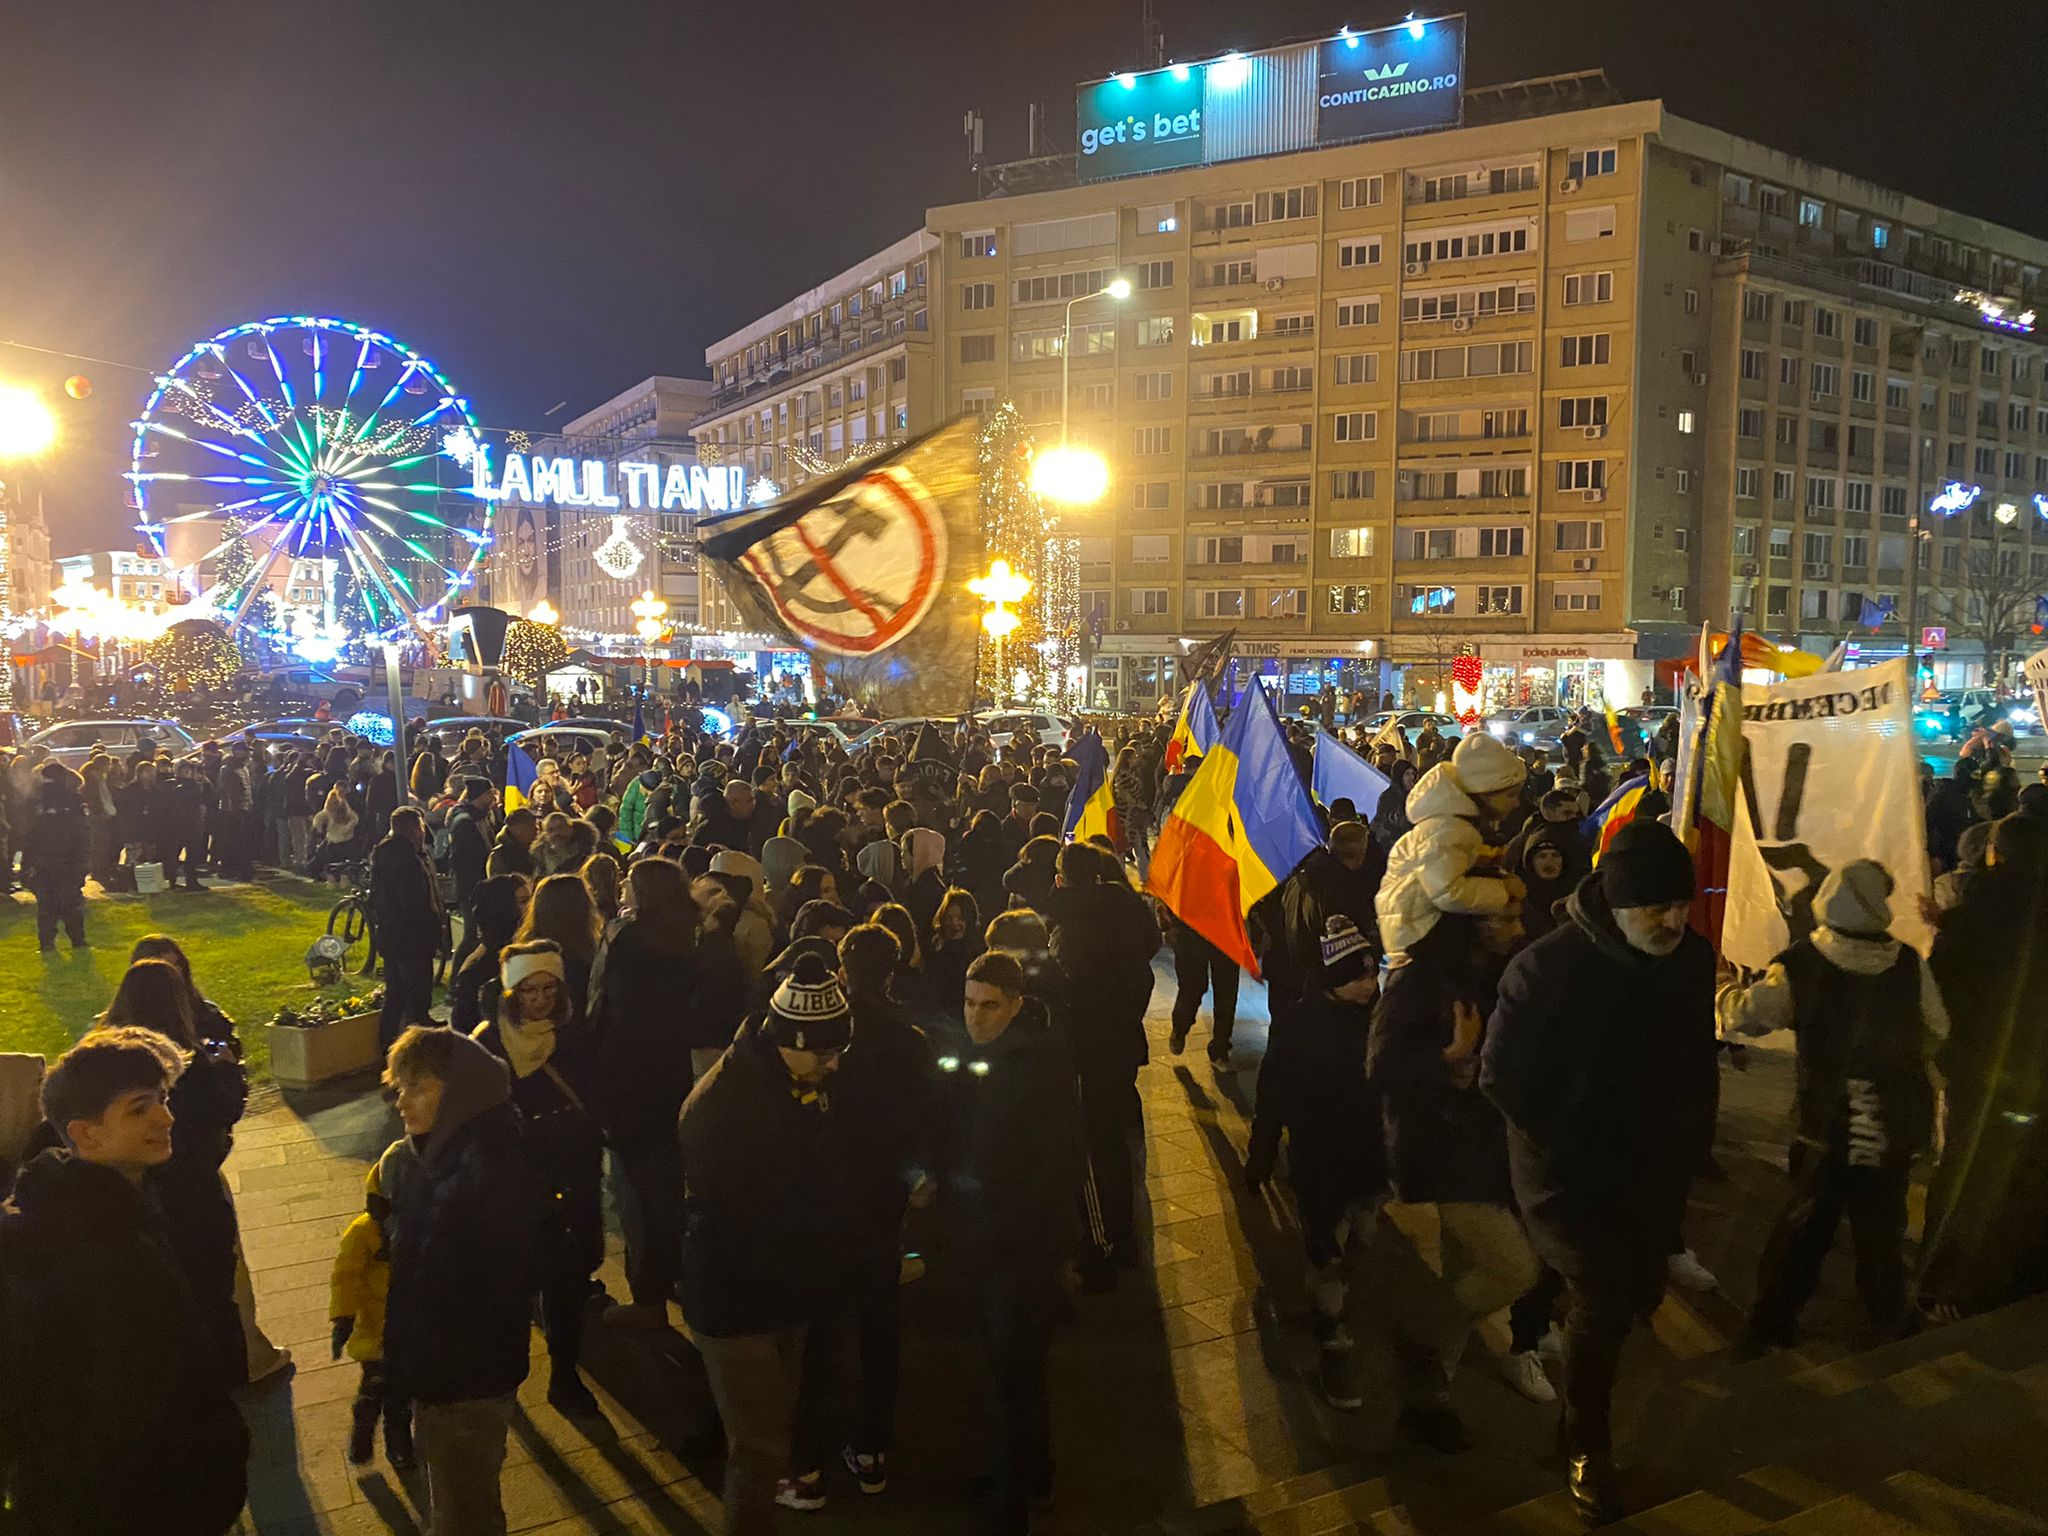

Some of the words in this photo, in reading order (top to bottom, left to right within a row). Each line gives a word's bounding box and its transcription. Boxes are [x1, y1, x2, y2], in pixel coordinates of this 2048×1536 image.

[1320, 73, 1457, 108] CONTICAZINO.RO
[1081, 116, 1146, 155] get's
[1153, 108, 1200, 138] bet
